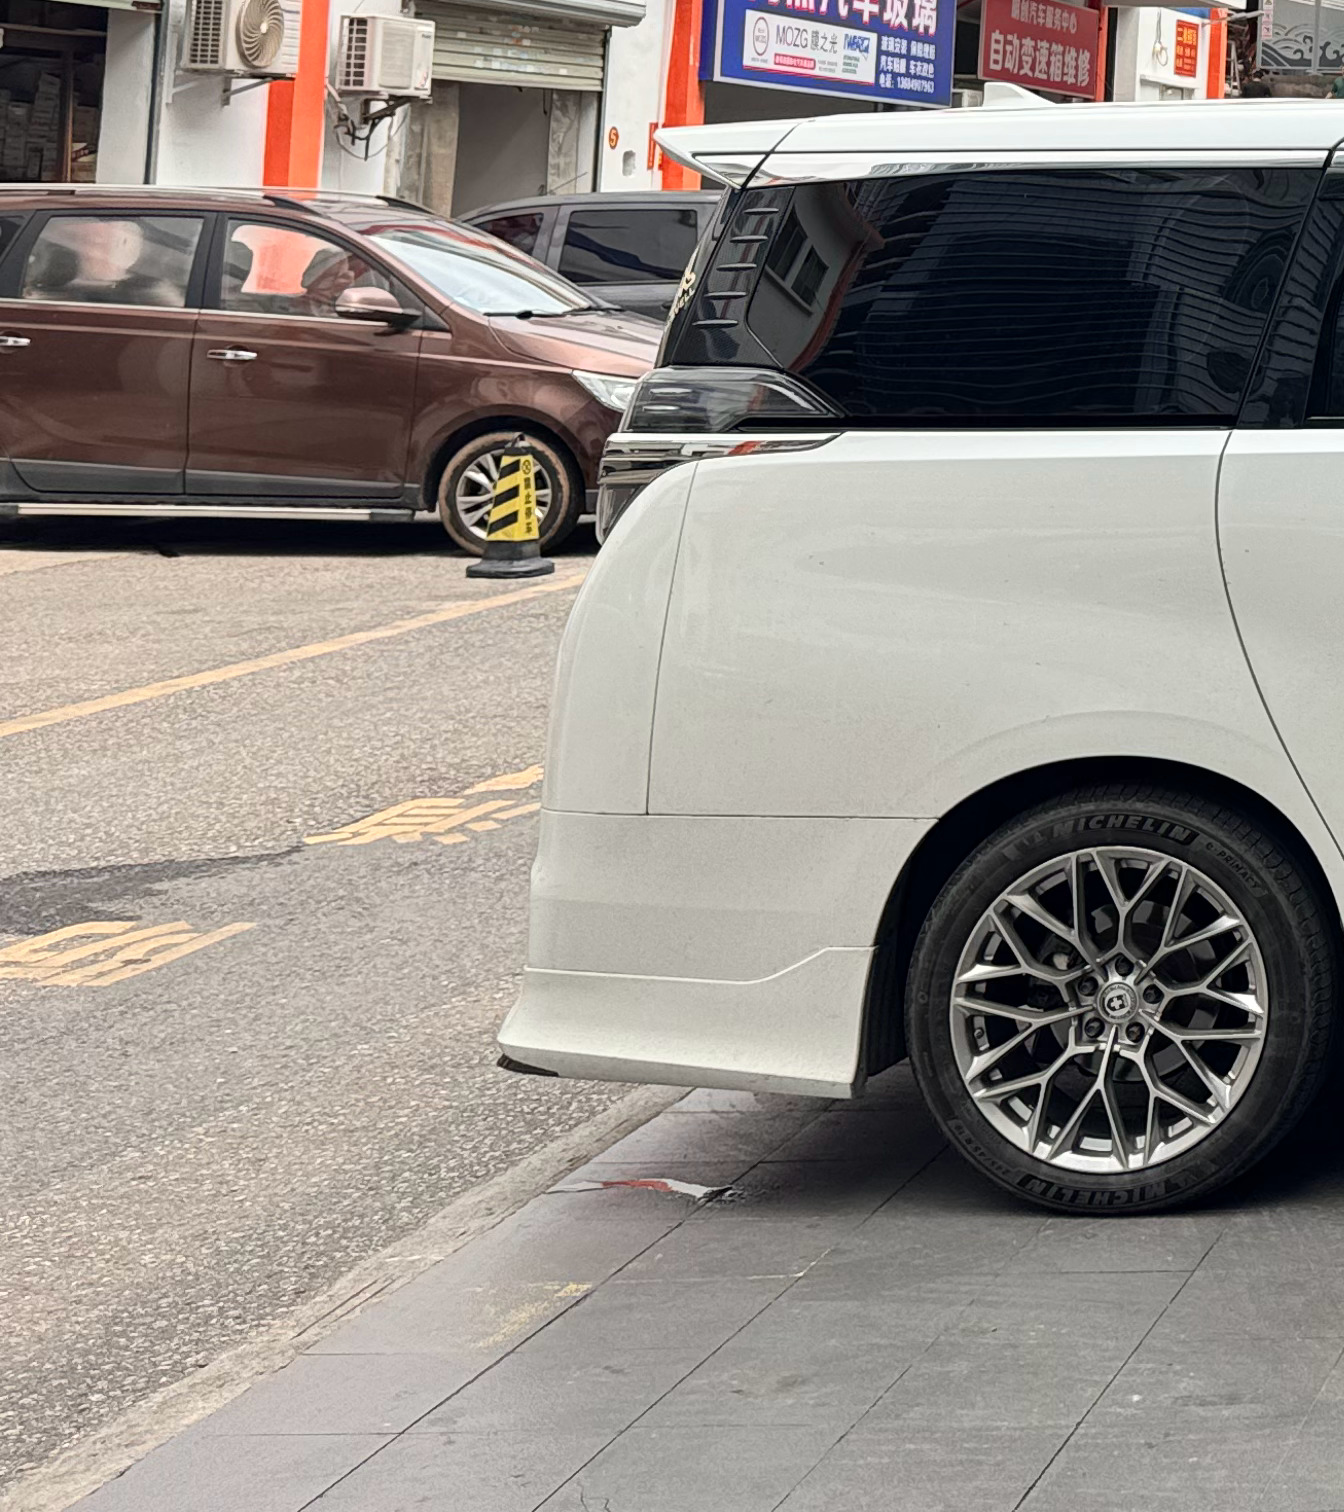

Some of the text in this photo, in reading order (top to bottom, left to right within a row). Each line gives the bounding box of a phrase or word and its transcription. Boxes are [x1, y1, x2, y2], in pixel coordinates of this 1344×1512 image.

[775, 24, 808, 48] MOZG
[989, 29, 1091, 87] 自动变速箱维修
[1052, 814, 1196, 843] MICHELIN
[1023, 1176, 1166, 1207] MICHELIN
